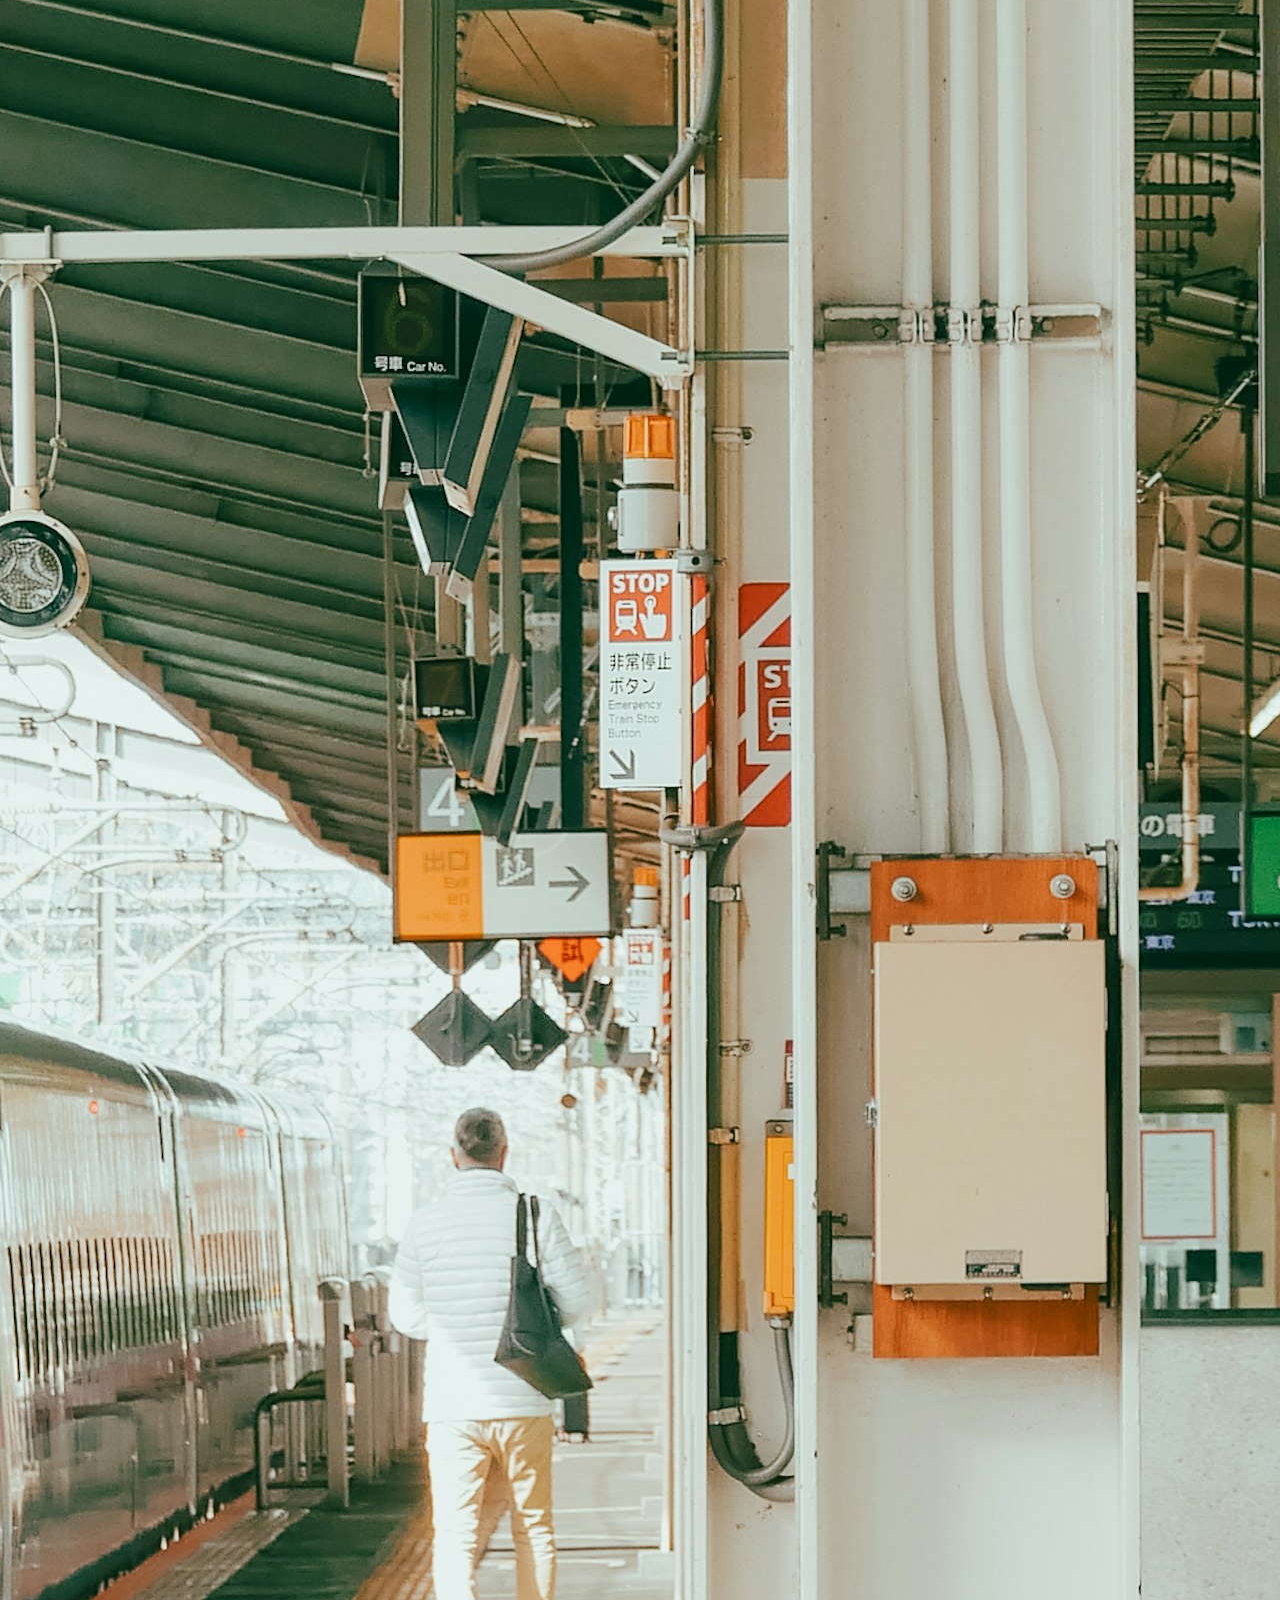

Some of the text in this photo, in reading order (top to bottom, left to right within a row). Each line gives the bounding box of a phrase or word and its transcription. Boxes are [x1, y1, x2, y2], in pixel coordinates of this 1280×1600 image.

[374, 355, 403, 372] 号車
[406, 360, 426, 372] Car
[612, 573, 670, 594] STOP
[609, 651, 672, 672] 非常停止
[609, 677, 656, 695] ボタン
[608, 700, 662, 711] Emergency
[609, 714, 634, 724] Train
[608, 729, 641, 739] Button
[427, 777, 465, 827] 4
